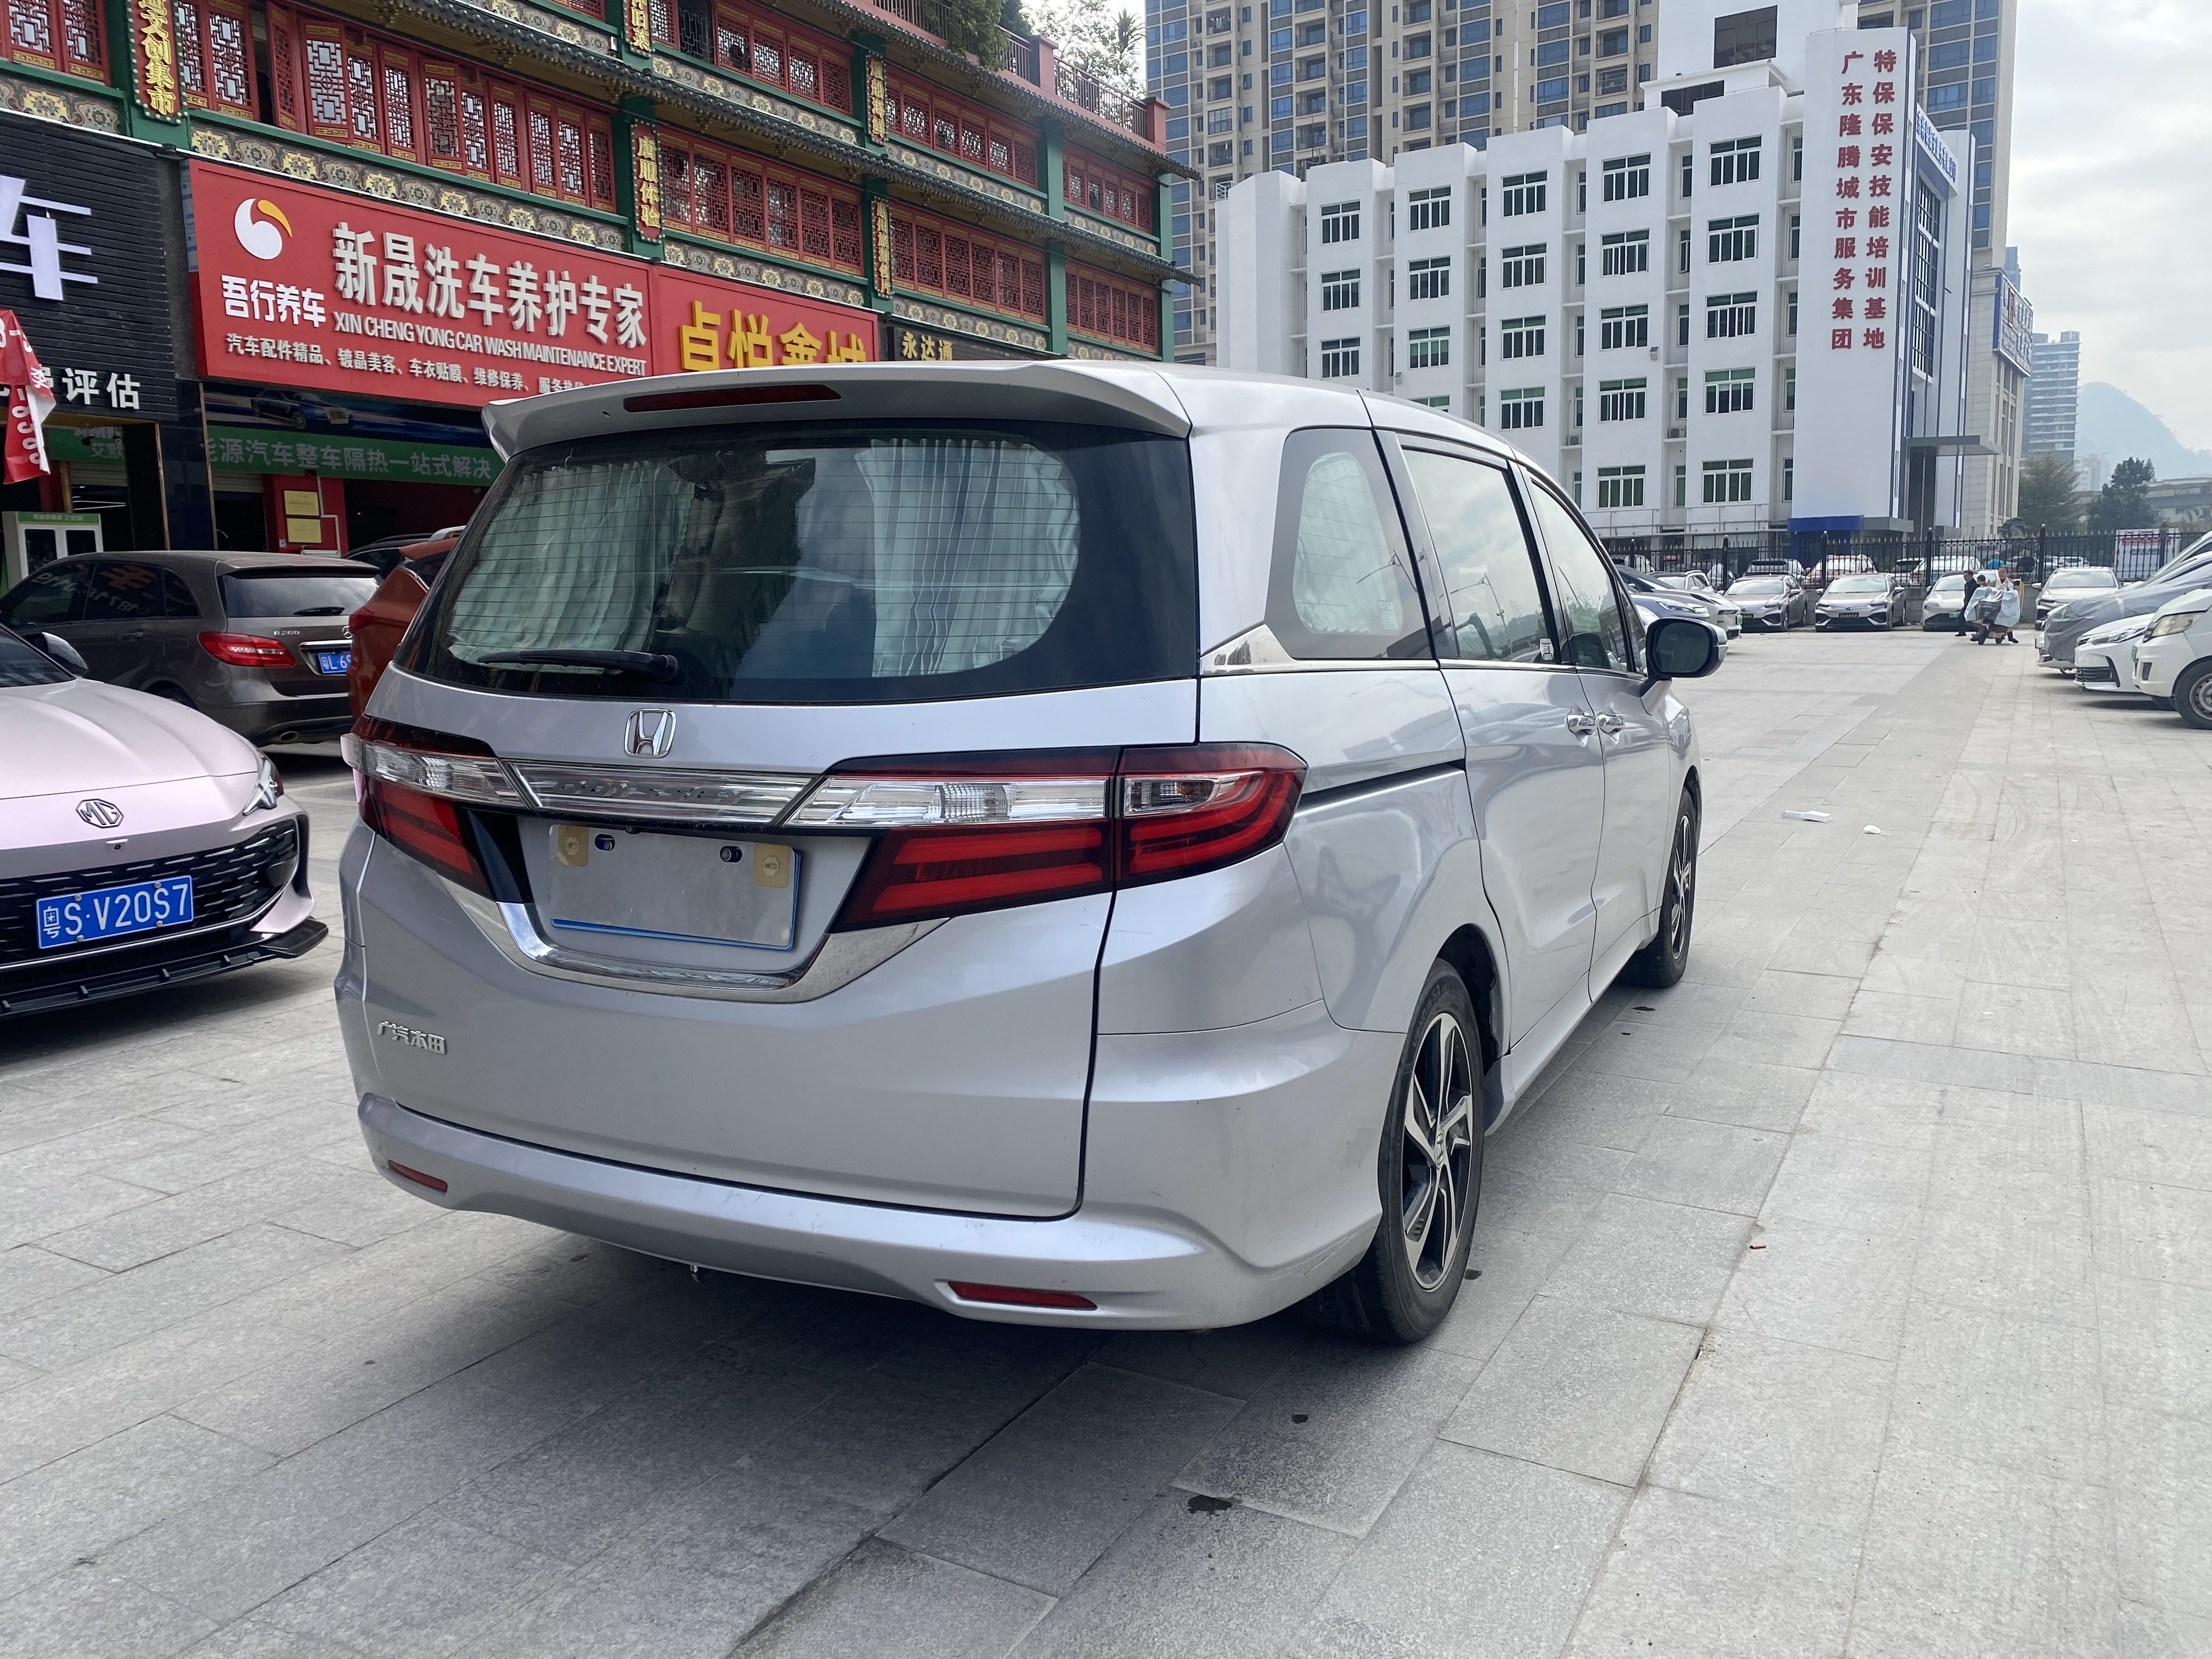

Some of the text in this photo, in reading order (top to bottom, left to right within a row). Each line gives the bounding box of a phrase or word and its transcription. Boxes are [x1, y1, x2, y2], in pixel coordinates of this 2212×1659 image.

[637, 136, 661, 228] 唐服体验
[1832, 51, 1864, 349] 广东隆腾城市服务集团
[1863, 49, 1897, 349] 特保保安技能培训基地
[221, 274, 326, 328] 吾行养车
[332, 221, 647, 349] 新晟洗车养护专家
[332, 311, 647, 376] XIN CHENG YONG CAR WASH MAINTENANCE EXPERT
[902, 331, 953, 361] 永达通
[80, 801, 121, 826] MG
[552, 780, 754, 805] ODYSSEY
[376, 1020, 447, 1054] 广汽本田
